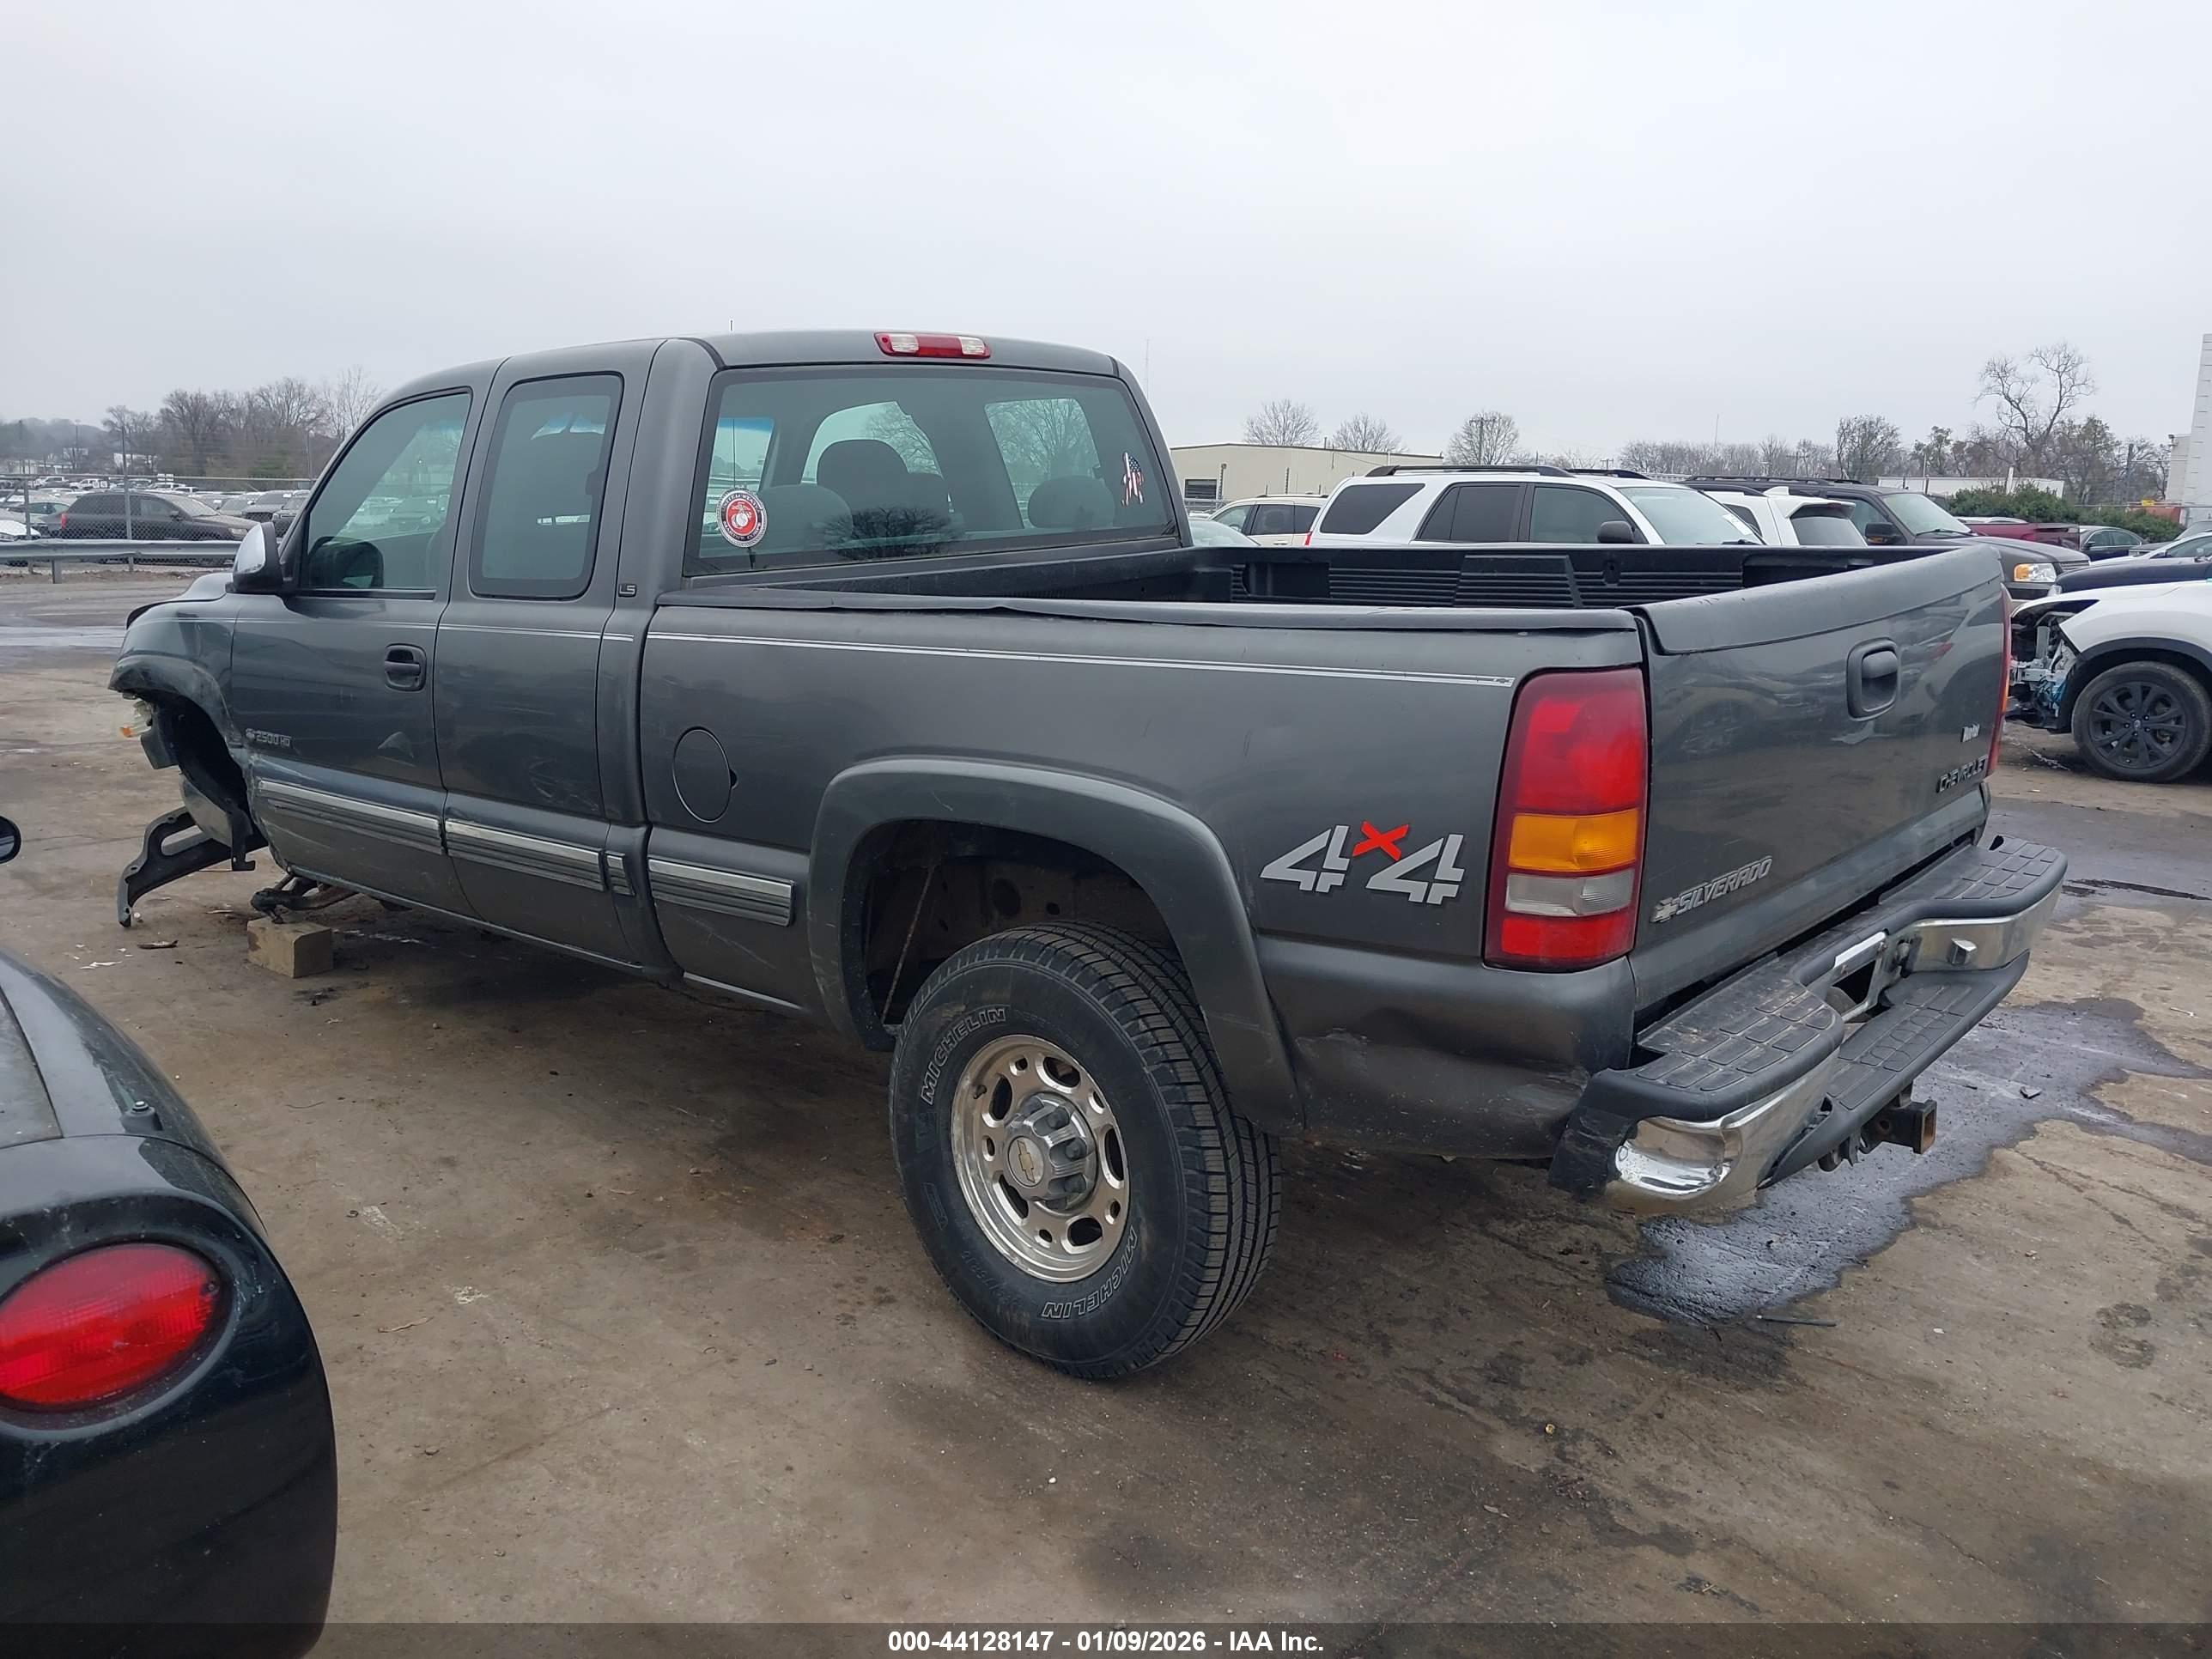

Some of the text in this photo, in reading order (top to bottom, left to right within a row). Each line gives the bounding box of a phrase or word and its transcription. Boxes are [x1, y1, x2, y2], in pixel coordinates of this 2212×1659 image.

[619, 585, 635, 595] LS
[257, 731, 279, 744] 2500
[1675, 855, 1772, 915] SILVERADO
[921, 1008, 1006, 1105] MICHELIN
[1042, 1224, 1138, 1318] MICHELIN
